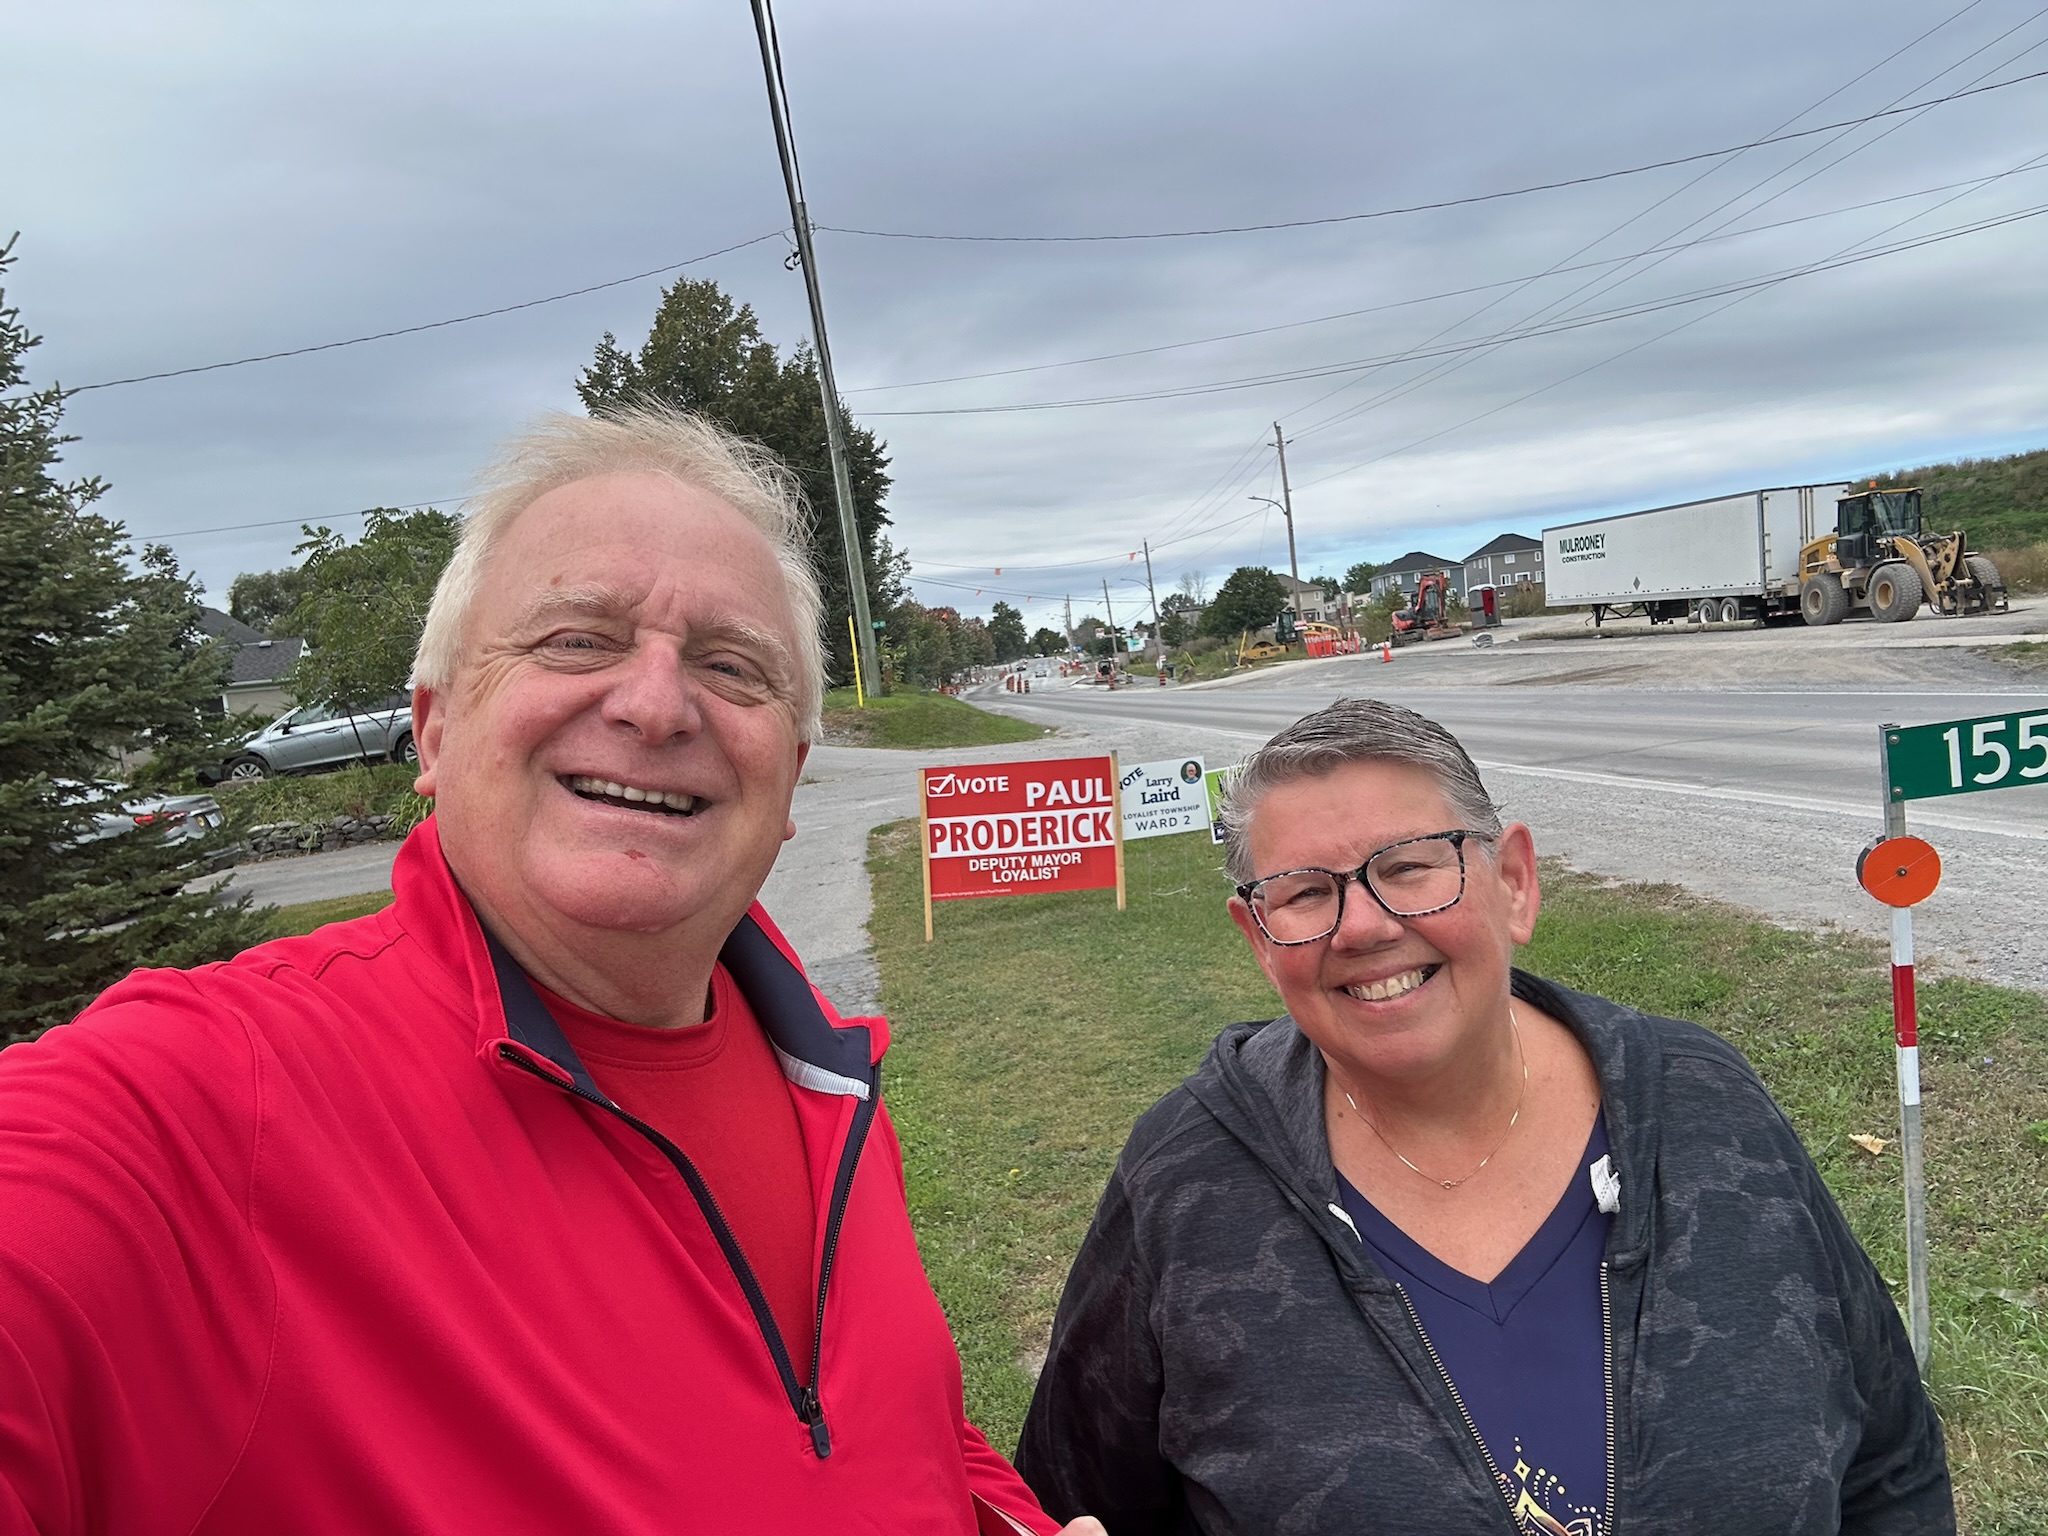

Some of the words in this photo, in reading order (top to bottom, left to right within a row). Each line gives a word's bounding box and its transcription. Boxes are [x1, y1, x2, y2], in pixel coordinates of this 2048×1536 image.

[1560, 533, 1605, 554] MULROONEY
[1562, 552, 1606, 564] CONSTRUCTION
[1943, 714, 2048, 788] 155
[1146, 777, 1173, 787] Larry
[956, 776, 1009, 794] VOTE
[1025, 777, 1112, 808] PAUL
[1141, 787, 1181, 805] Laird
[1123, 810, 1158, 820] LOYALIST
[1160, 804, 1200, 815] TOWNSHIP
[929, 811, 1114, 853] PRODERICK
[1135, 817, 1178, 831] WARD
[1183, 815, 1191, 825] 2
[969, 855, 1027, 872] DEPUTY
[1031, 852, 1082, 867] MAYOR
[992, 866, 1061, 883] LOYALIST
